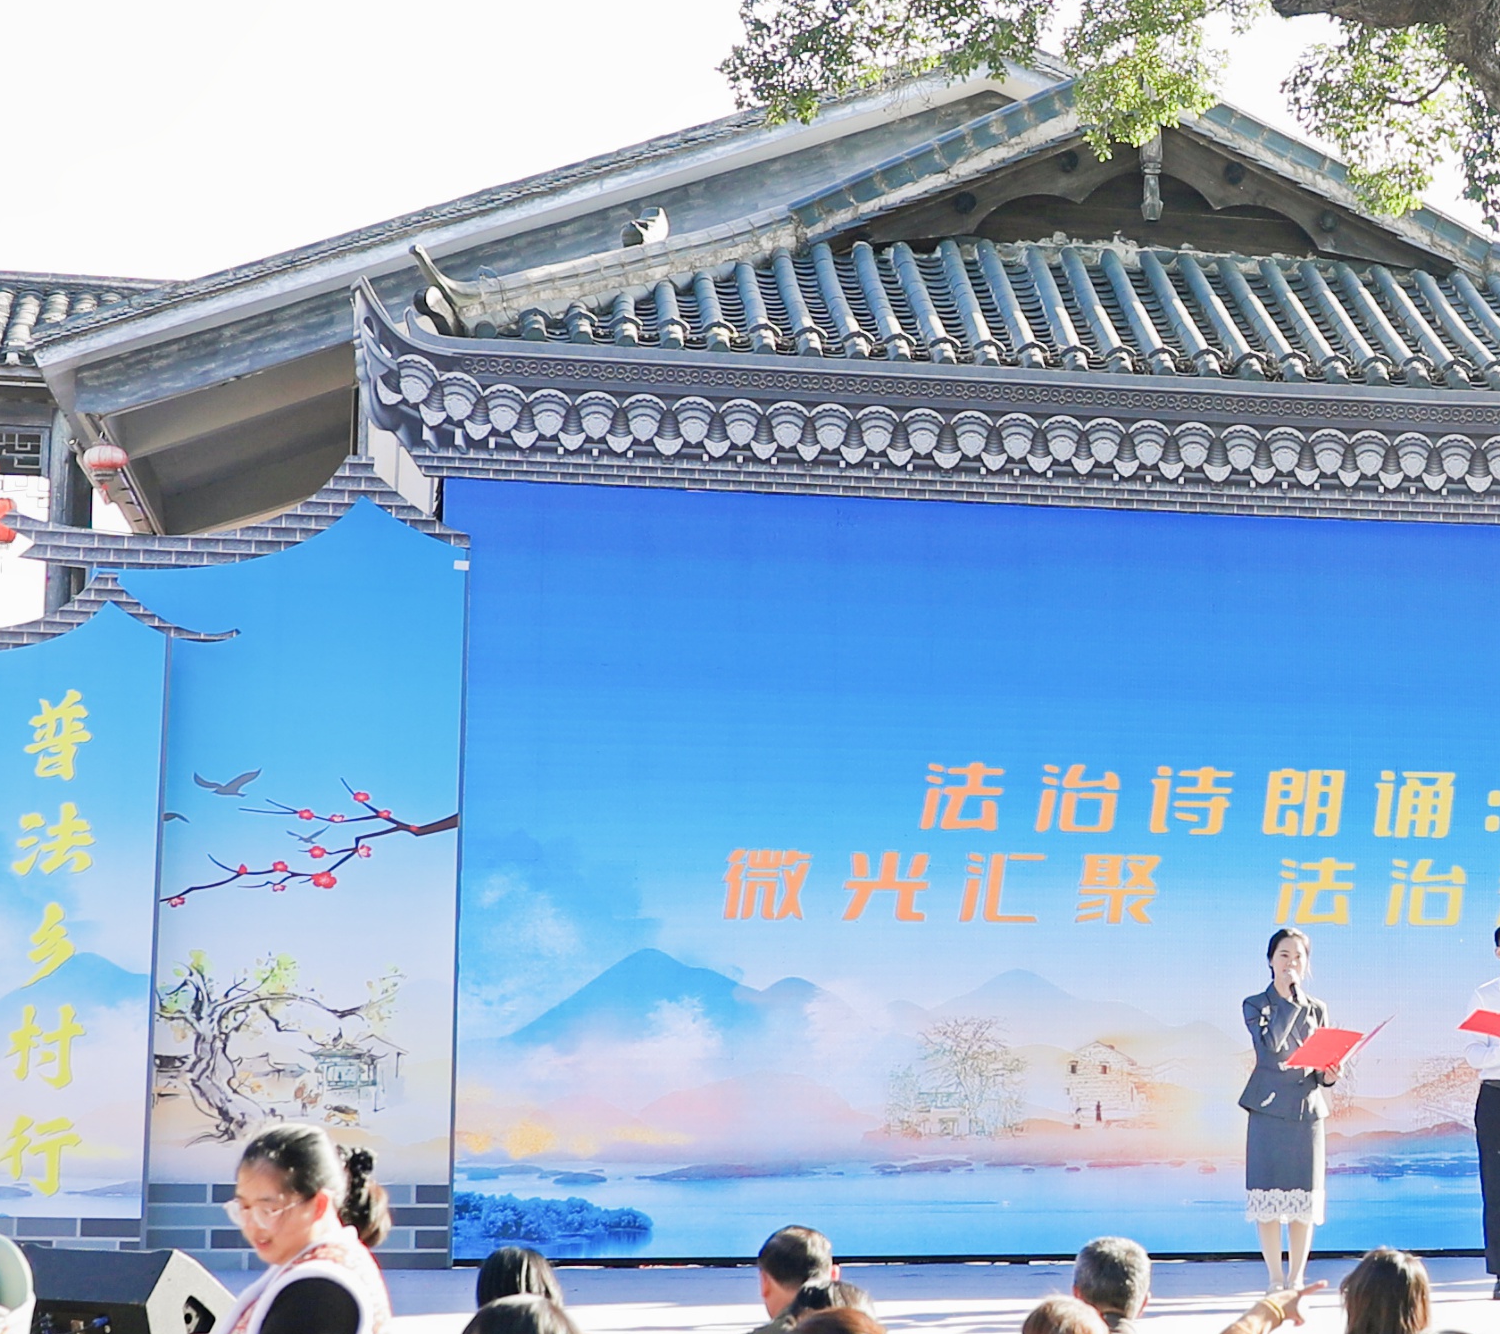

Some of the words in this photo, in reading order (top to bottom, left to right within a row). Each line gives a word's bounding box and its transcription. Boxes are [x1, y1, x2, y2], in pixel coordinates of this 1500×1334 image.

[0, 689, 96, 1196] 普法乡村行
[723, 848, 1163, 925] 微光汇聚
